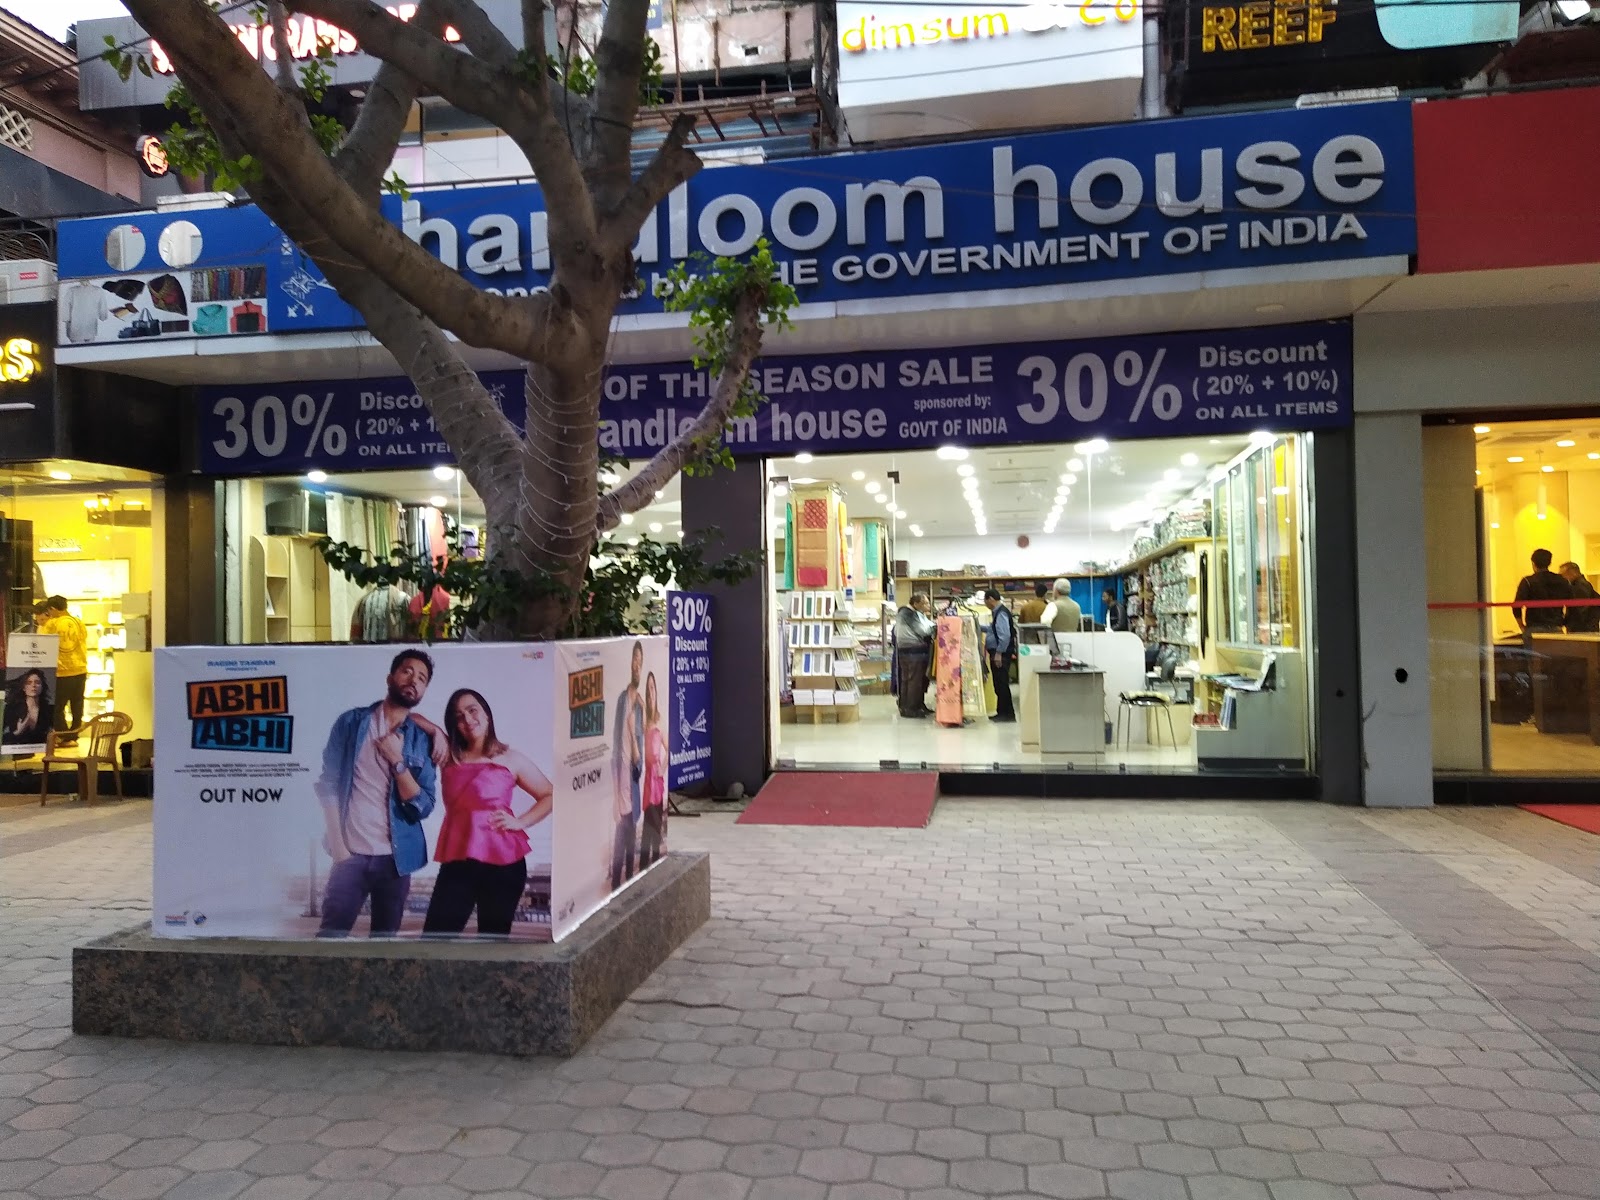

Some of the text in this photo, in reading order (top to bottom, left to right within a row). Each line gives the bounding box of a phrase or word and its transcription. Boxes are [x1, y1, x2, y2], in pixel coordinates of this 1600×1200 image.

[842, 12, 1009, 52] dimsum
[1202, 0, 1337, 53] REEF
[993, 134, 1385, 234] house
[831, 231, 1149, 282] GOVERNMENT
[1163, 223, 1228, 255] OF
[1239, 212, 1368, 249] INDIA
[1200, 340, 1327, 368] Discount
[604, 374, 648, 401] OF
[744, 363, 885, 396] SEASON
[899, 355, 993, 387] SALE
[1017, 348, 1182, 424] 30%
[914, 393, 991, 412] sponsored by:
[1196, 401, 1338, 420] ON ALL ITEMS
[212, 393, 347, 458] 30%
[771, 402, 887, 442] house
[899, 416, 1008, 438] GOVT OF INDIA
[358, 445, 380, 456] ON
[386, 444, 416, 455] ALL
[671, 596, 712, 633] 30%
[675, 636, 708, 652] Discount
[195, 682, 281, 715] ABHI
[572, 670, 602, 705] ABHI
[200, 718, 286, 749] ABHI
[670, 746, 712, 767] handloom house
[200, 788, 283, 803] OUT NOW
[572, 768, 602, 791] OUT NOW
